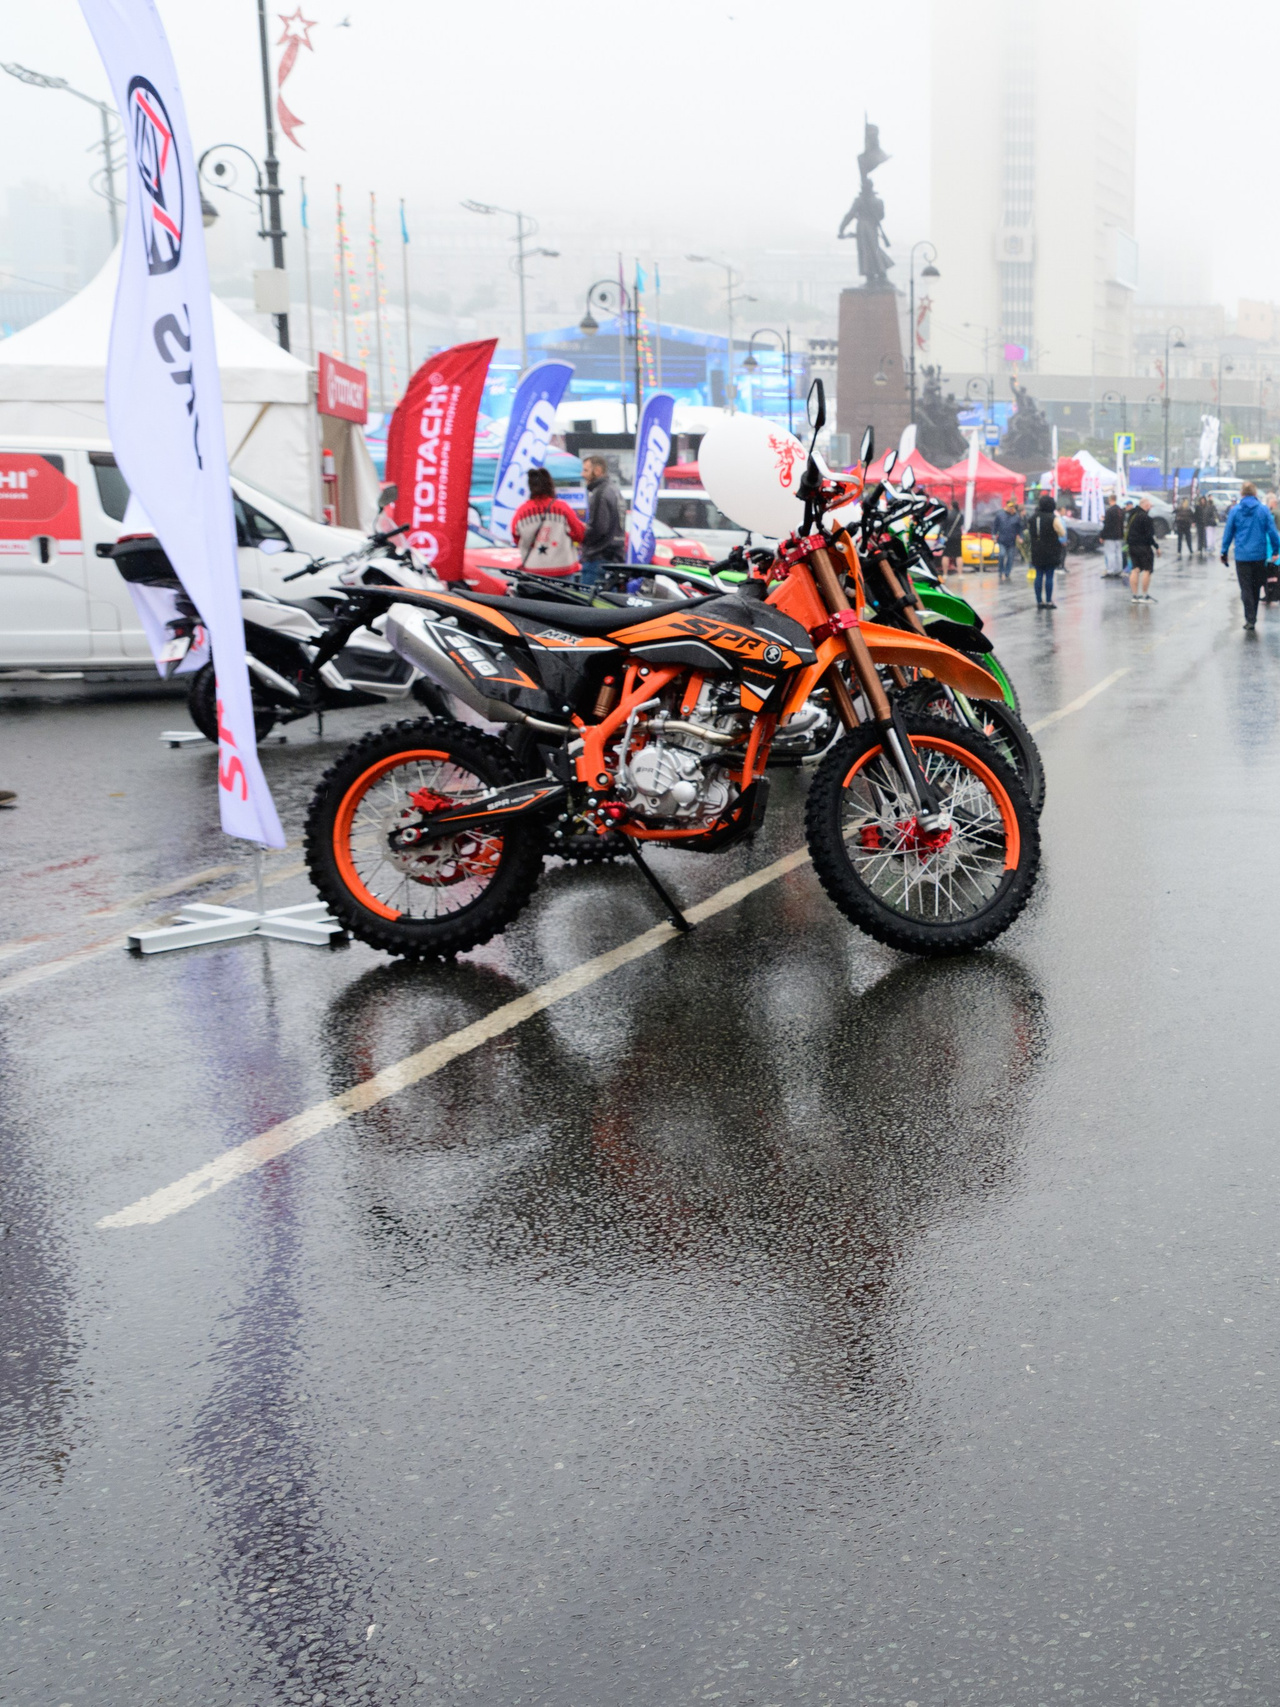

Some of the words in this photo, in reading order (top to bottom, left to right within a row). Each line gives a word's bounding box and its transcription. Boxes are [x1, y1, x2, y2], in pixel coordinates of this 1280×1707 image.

[412, 384, 439, 529] TOTACHI
[631, 424, 671, 554] ABRO
[535, 628, 583, 646] MAX
[668, 616, 766, 651] SPR
[444, 634, 499, 676] 300
[487, 798, 510, 811] SPR
